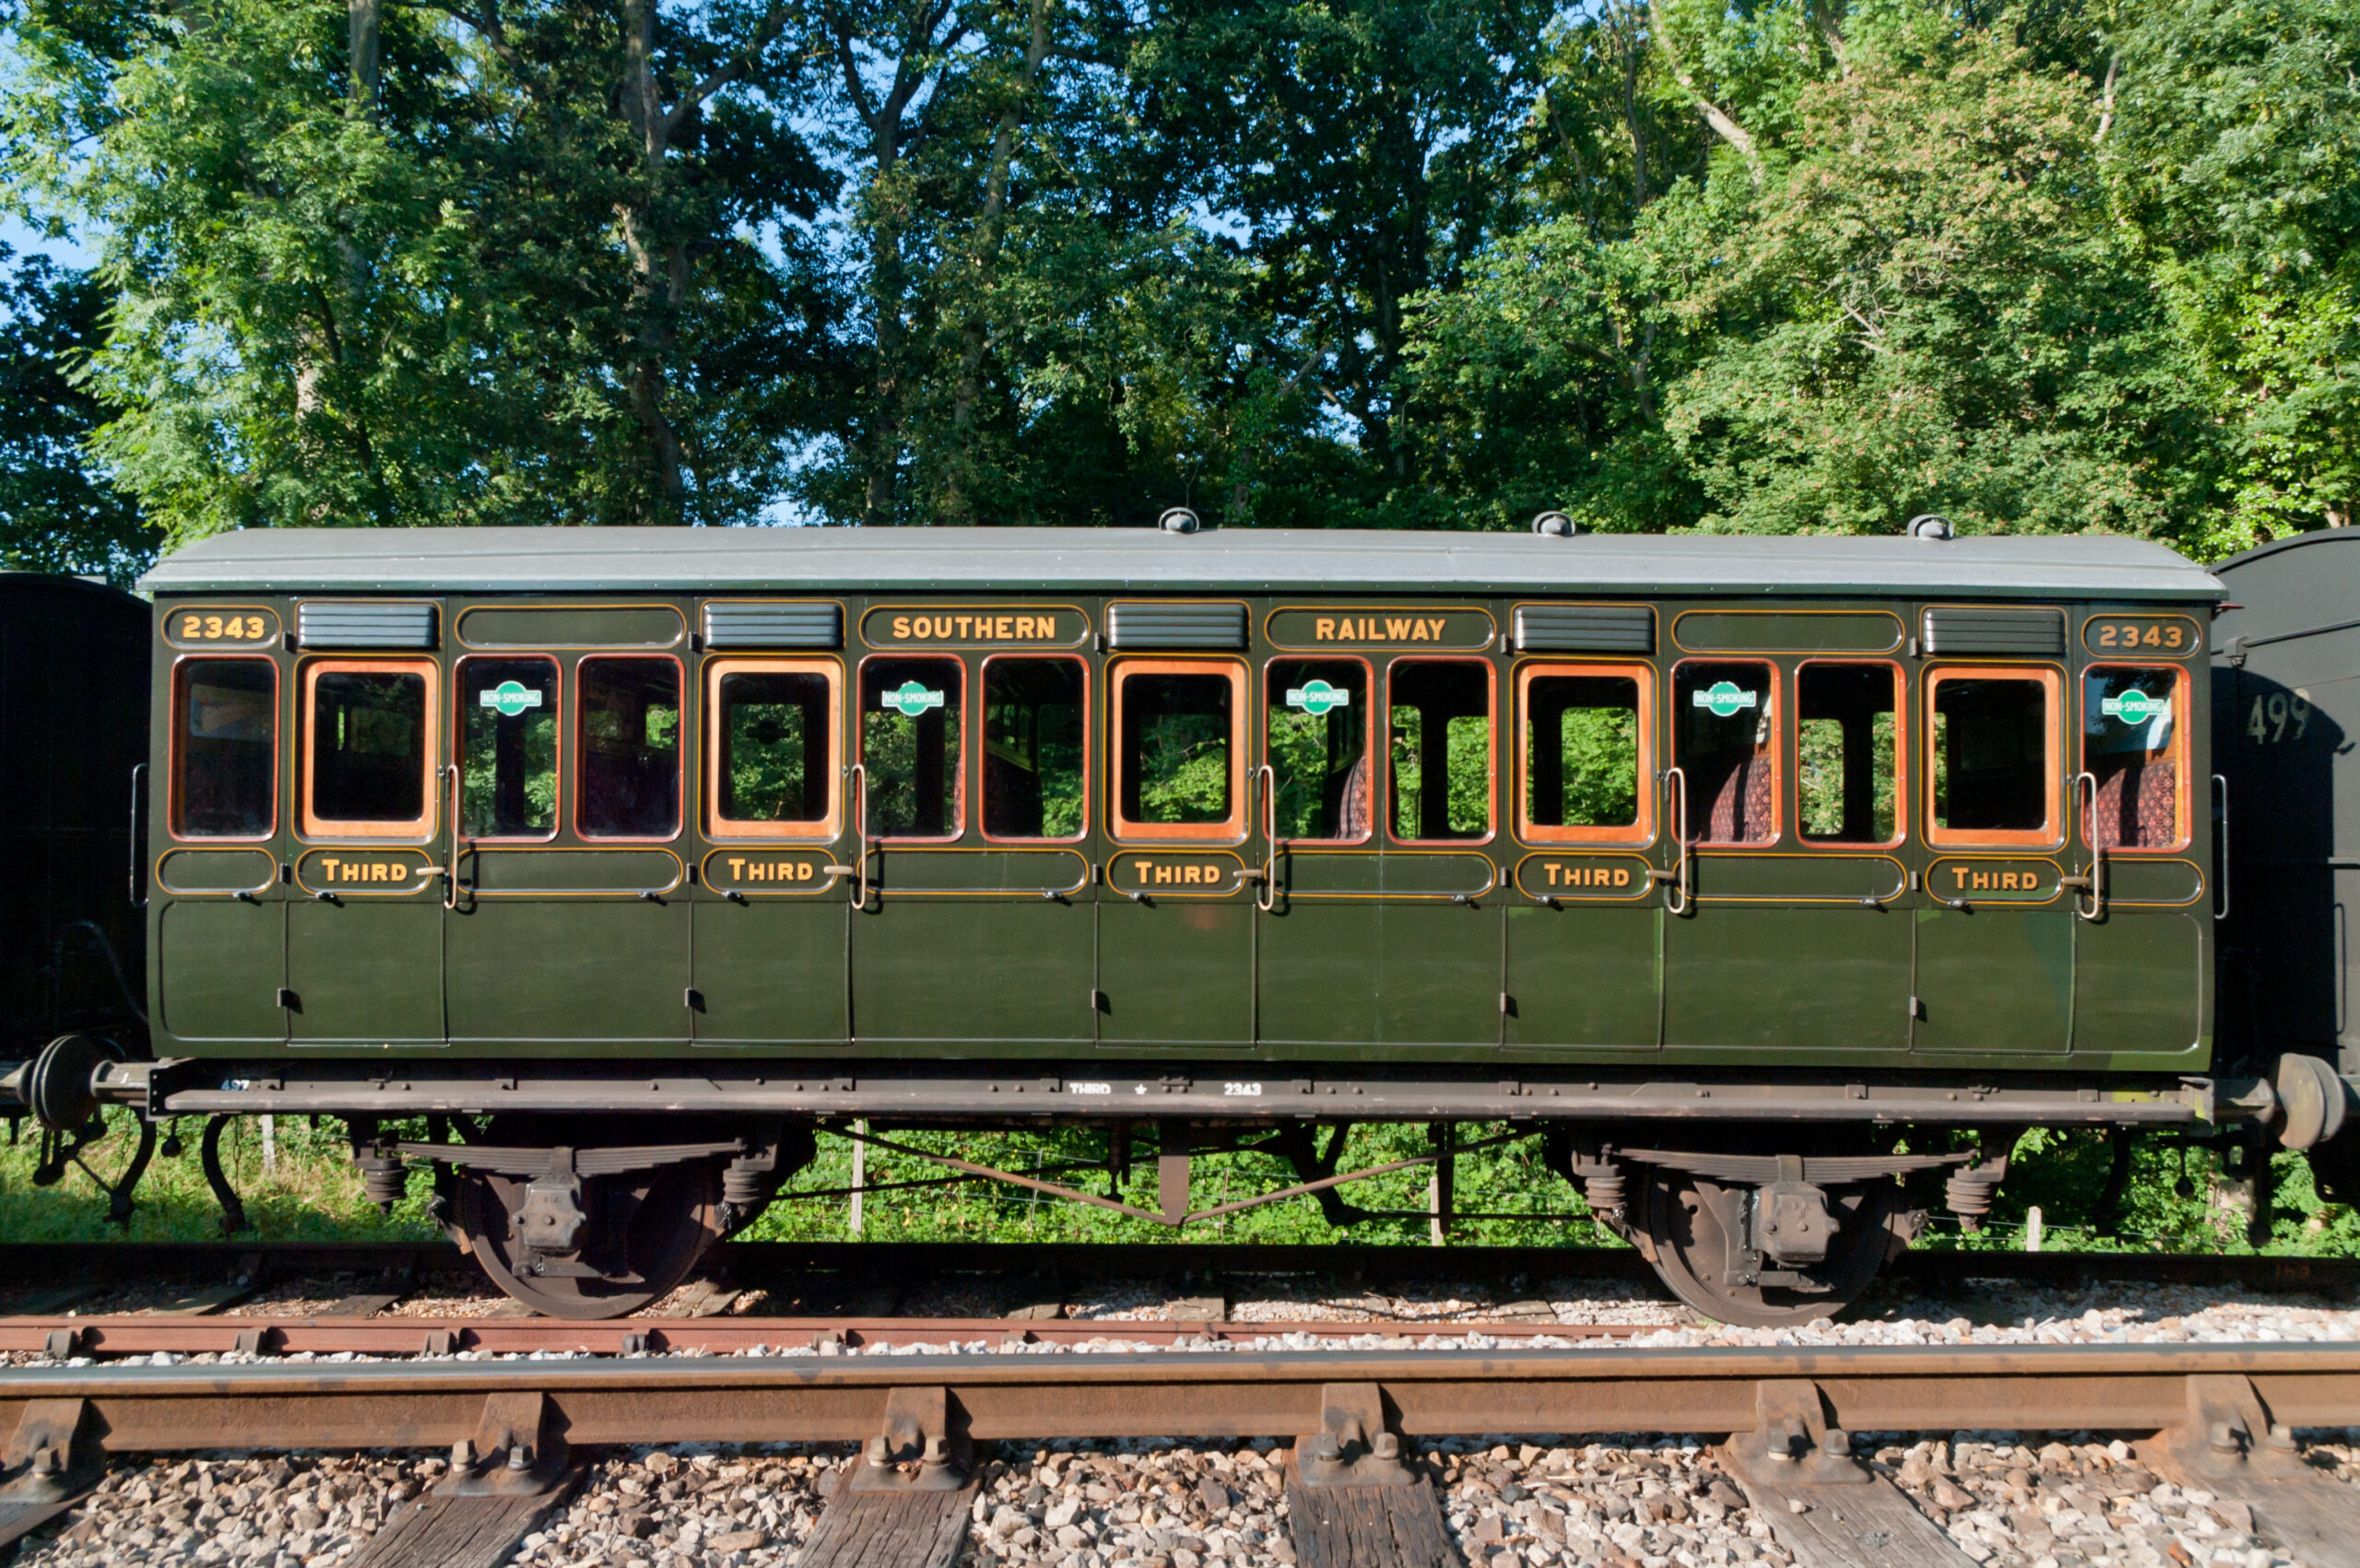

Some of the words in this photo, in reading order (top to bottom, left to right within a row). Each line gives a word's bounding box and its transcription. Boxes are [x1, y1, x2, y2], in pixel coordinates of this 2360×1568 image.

[183, 617, 266, 639] 2343
[892, 616, 1056, 639] SOUTHERN
[1316, 618, 1446, 641] RAILWAY
[2100, 625, 2183, 647] 2343
[483, 693, 538, 703] NON-SMOKING
[885, 693, 939, 703] NON-SMOKING
[1290, 692, 1345, 702] NON-SMOKING
[1696, 693, 1753, 703] NON-SMOKING
[2105, 701, 2161, 712] NON-SMOKING
[2248, 688, 2310, 744] 499
[322, 858, 407, 881] THIRD
[728, 857, 813, 881] THIRD
[1135, 861, 1221, 884] THIRD
[1545, 863, 1630, 886] THIRD
[1953, 867, 2038, 890] THIRD
[1069, 1083, 1112, 1095] THIRD
[1224, 1083, 1262, 1096] 2343
